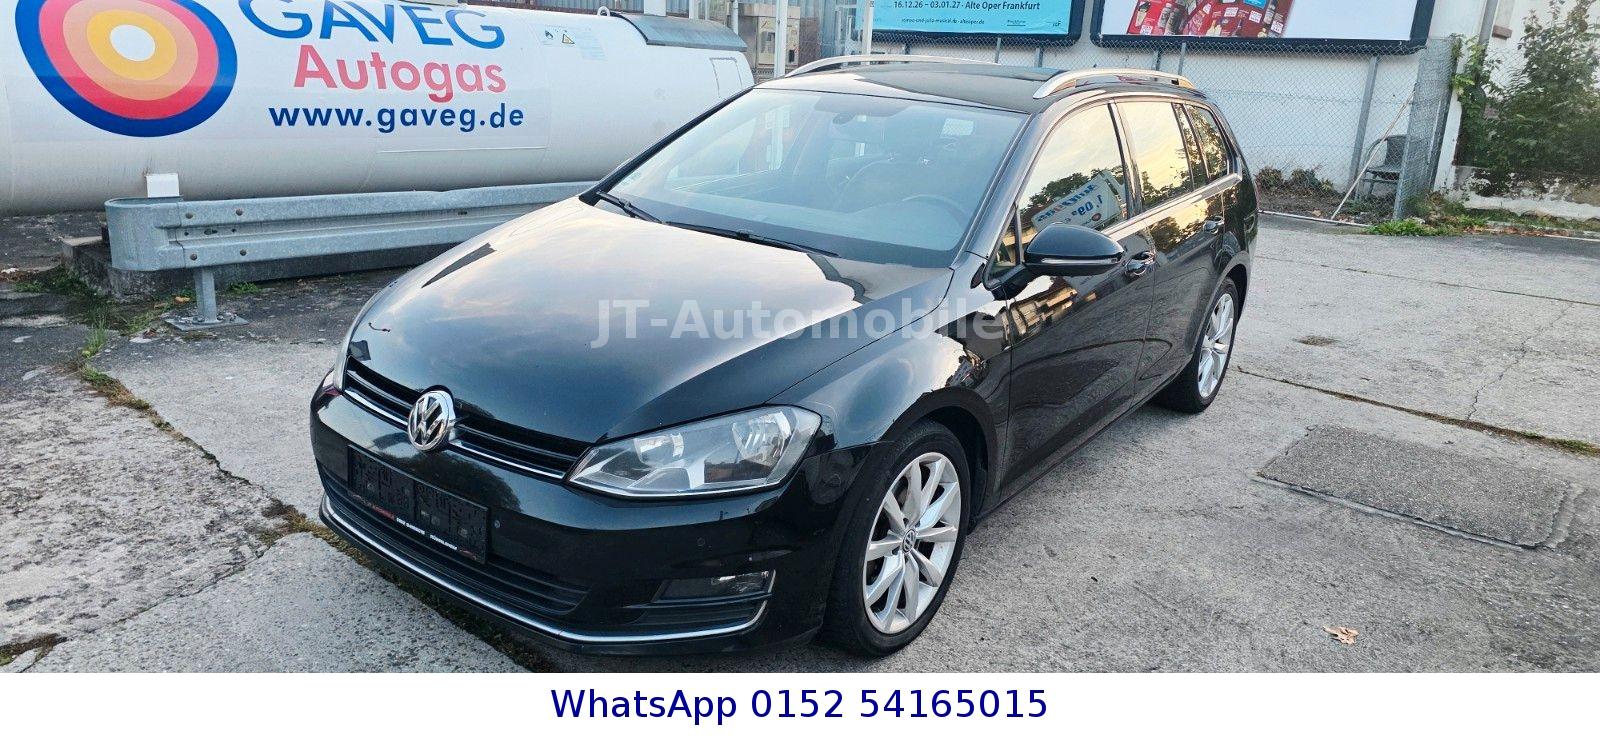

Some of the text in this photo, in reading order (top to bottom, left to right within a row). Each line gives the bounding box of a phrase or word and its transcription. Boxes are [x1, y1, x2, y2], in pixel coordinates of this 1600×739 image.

[239, 0, 505, 49] GAVEG
[930, 1, 960, 9] 03.01.27
[965, 1, 980, 9] Alte
[982, 1, 1001, 11] Oper
[1002, 2, 1040, 10] Frankfurt
[293, 44, 507, 103] Autogas
[268, 103, 524, 133] www.gaveg.de
